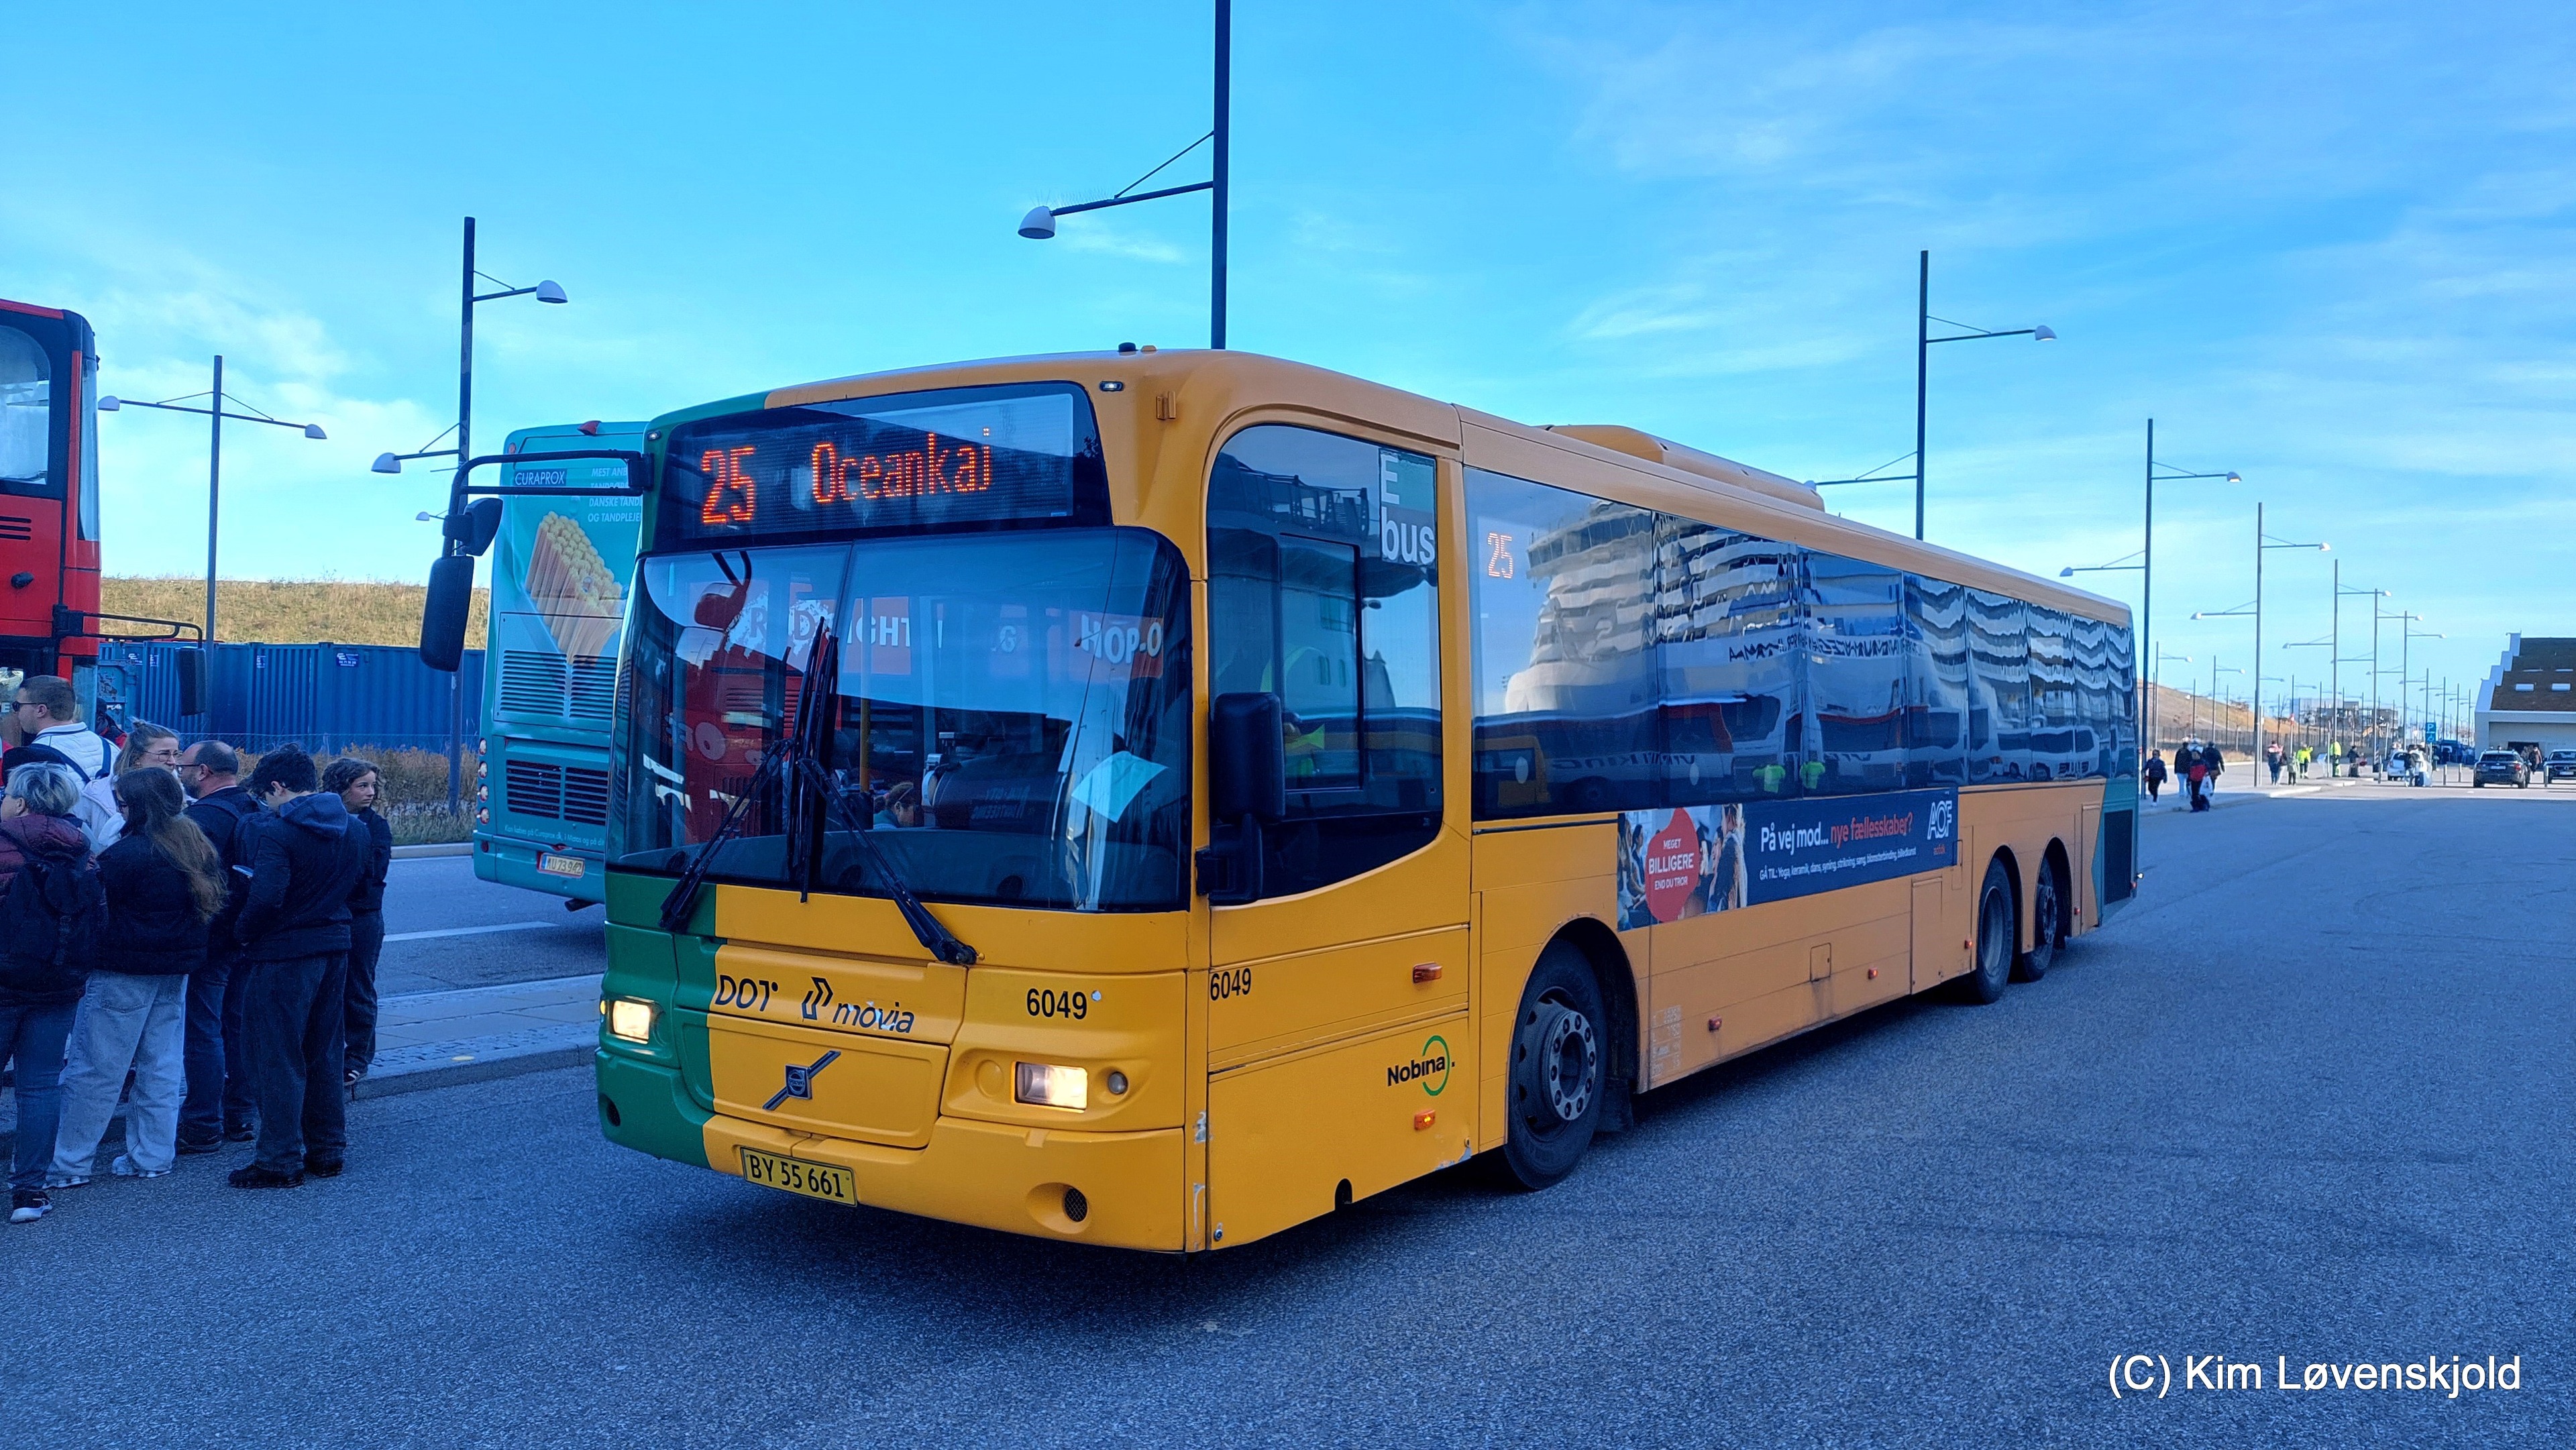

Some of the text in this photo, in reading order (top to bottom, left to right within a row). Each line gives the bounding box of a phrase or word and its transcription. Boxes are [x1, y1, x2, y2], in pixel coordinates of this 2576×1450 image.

[515, 471, 565, 486] CURAPROX
[591, 467, 610, 477] MEST
[701, 427, 991, 525] 25 Oceankaj
[1381, 454, 1400, 505] E
[588, 513, 600, 522] OG
[589, 497, 619, 507] DANSKE
[1381, 506, 1435, 565] bus
[1487, 533, 1514, 579] 25
[2427, 723, 2434, 731] P
[1927, 800, 1953, 840] AOF
[1663, 838, 1682, 850] MEGET
[1760, 822, 1776, 852] På
[1778, 822, 1796, 856] vej
[1796, 821, 1829, 848] mod...
[1831, 824, 1849, 849] nye
[557, 859, 568, 871] 73
[1648, 852, 1695, 875] BILLIGERE
[1654, 879, 1666, 891] END
[1666, 878, 1674, 889] DU
[714, 974, 779, 1012] DOT
[1210, 968, 1252, 1001] 6049
[1026, 988, 1087, 1020] 6049
[749, 1154, 845, 1198] BY 55 661
